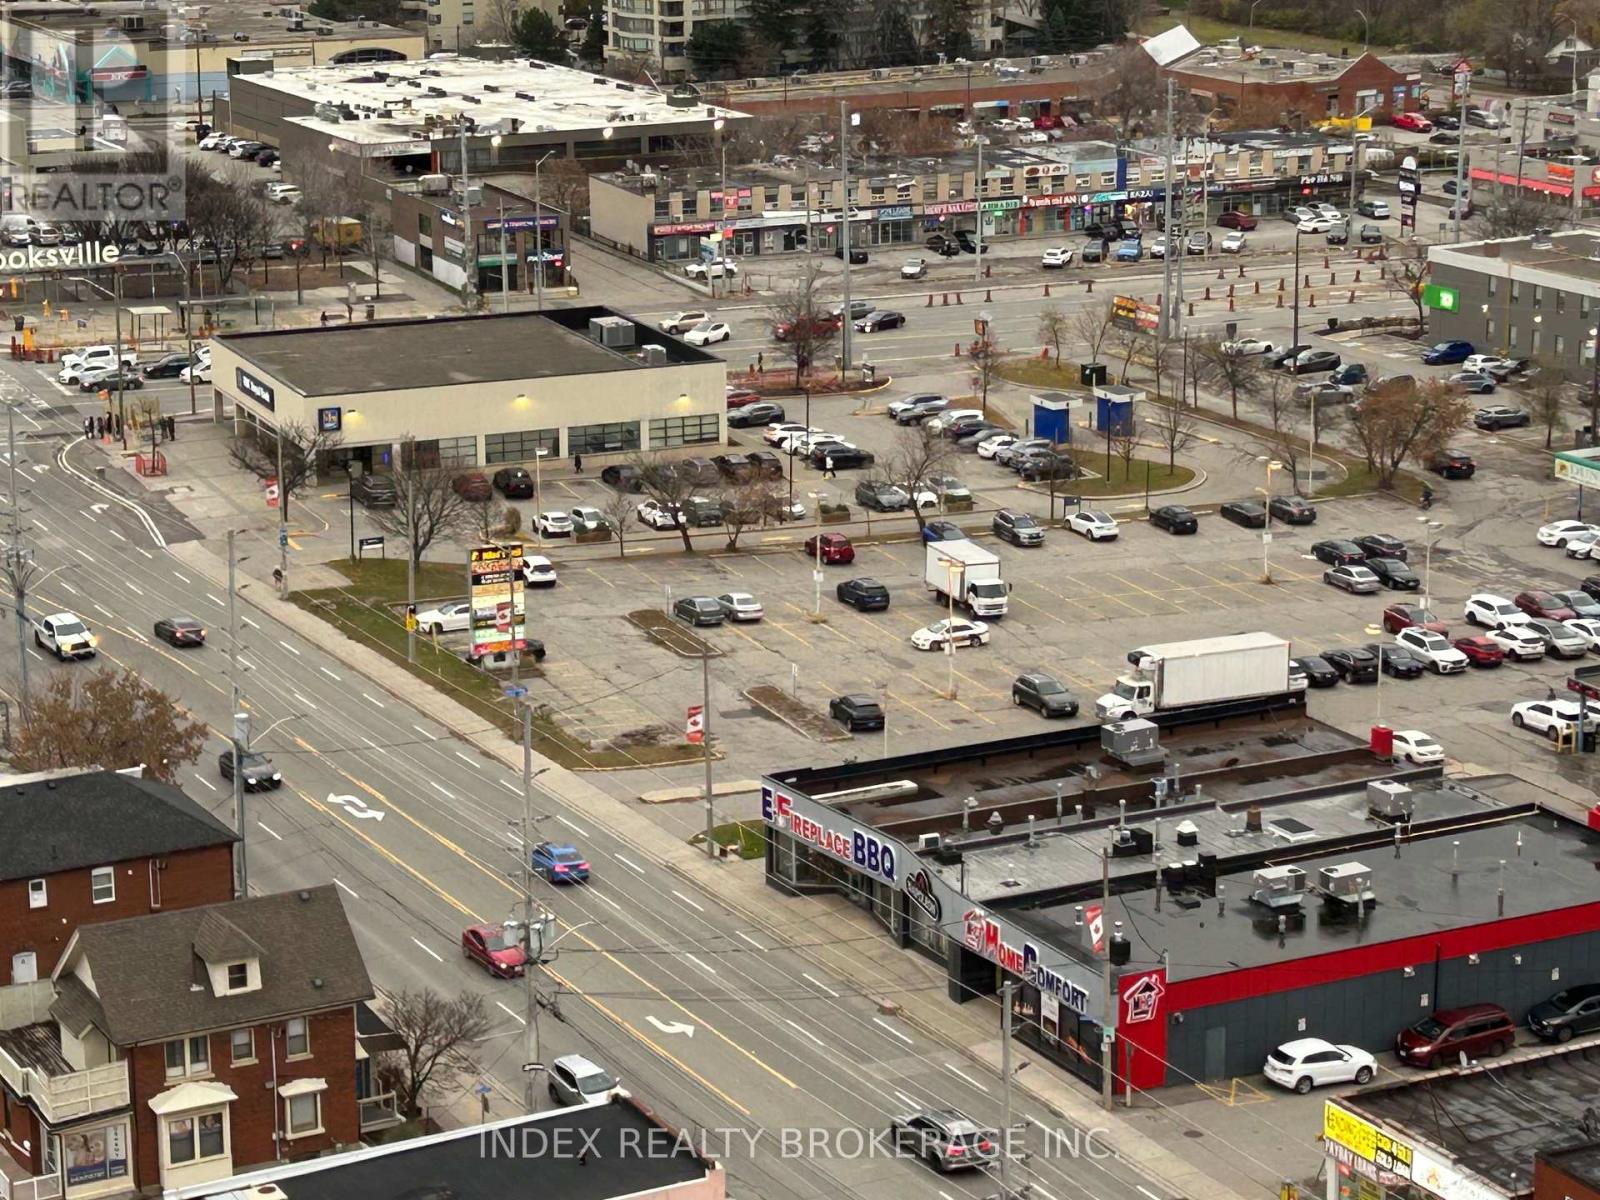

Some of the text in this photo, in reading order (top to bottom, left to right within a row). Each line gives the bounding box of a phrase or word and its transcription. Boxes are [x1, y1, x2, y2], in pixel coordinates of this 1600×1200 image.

[853, 828, 898, 883] BBQ
[984, 917, 1024, 976] HOME
[1022, 941, 1090, 1015] COMFORT
